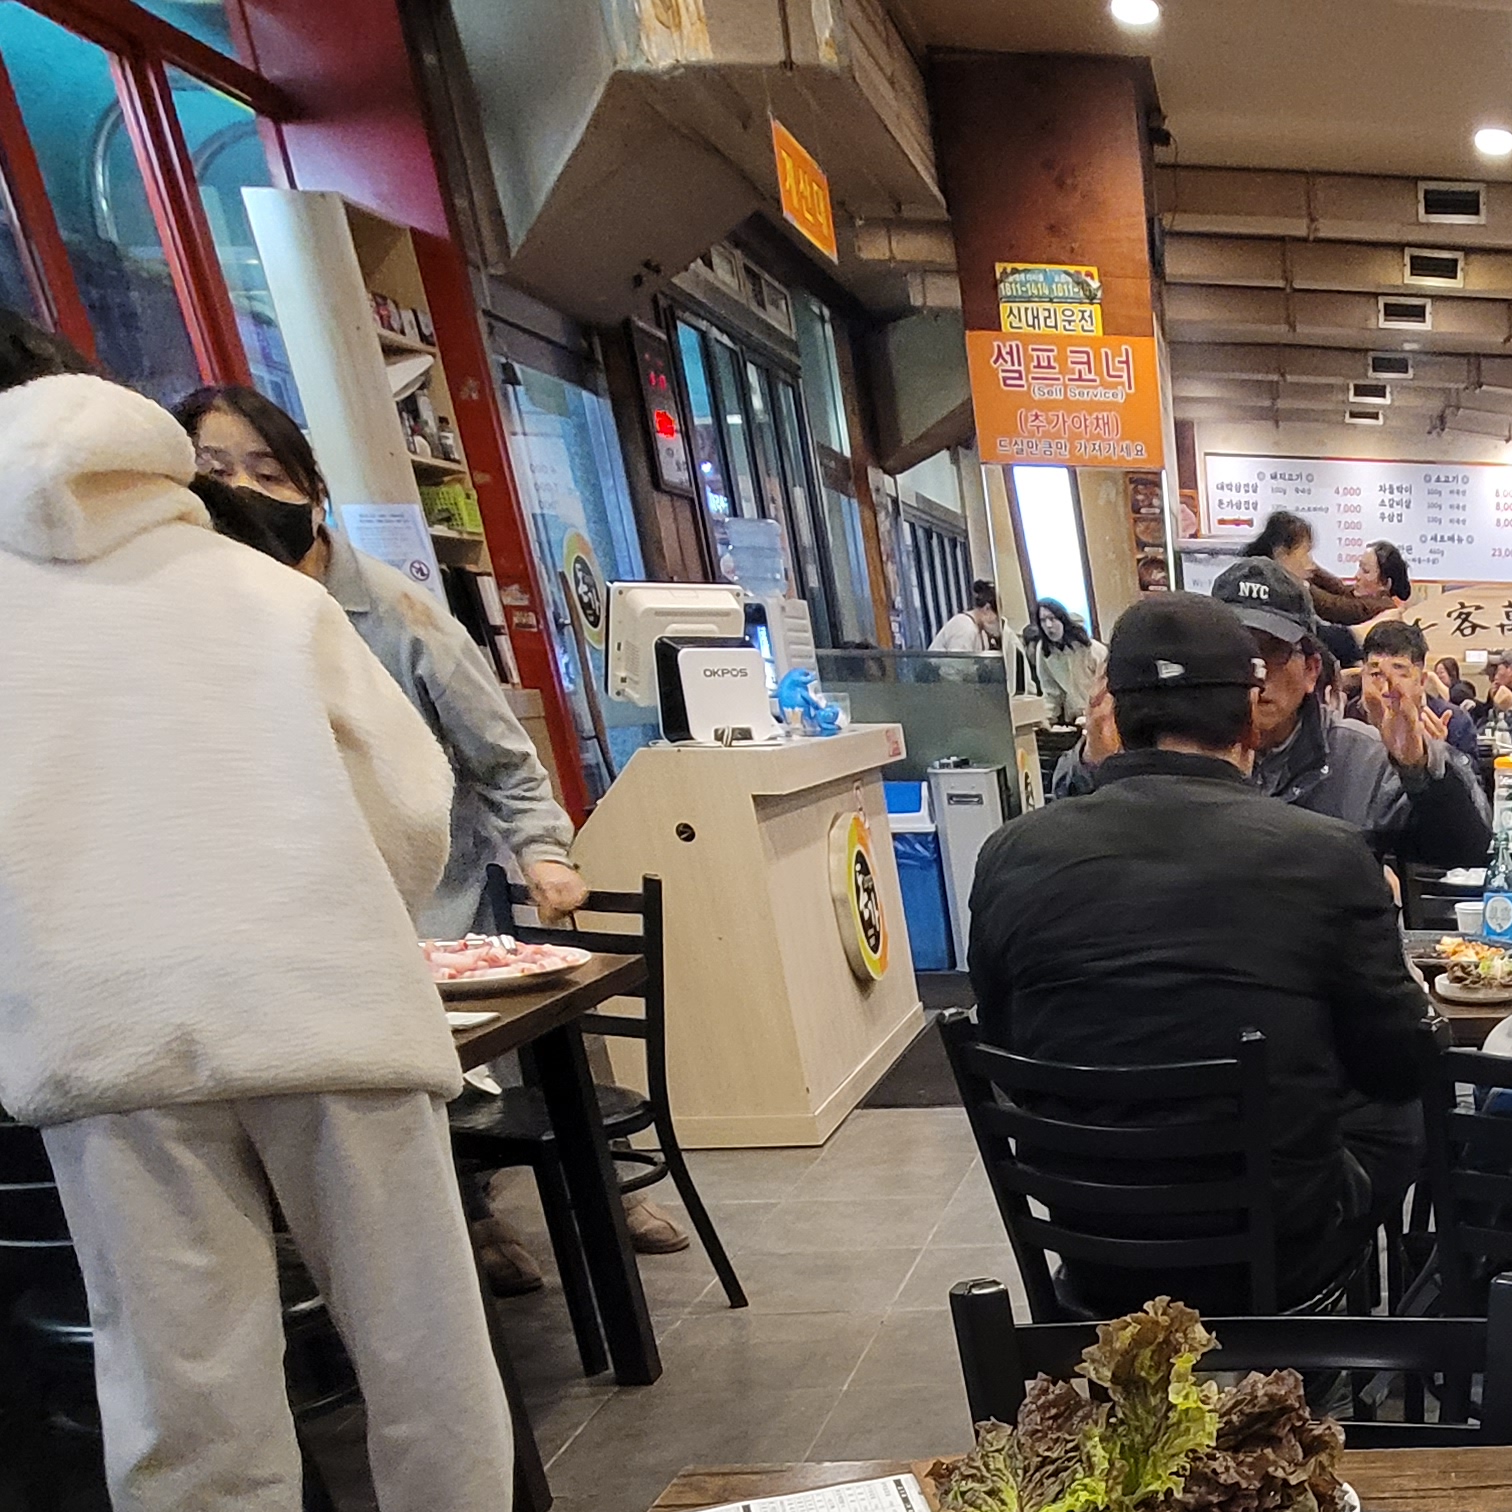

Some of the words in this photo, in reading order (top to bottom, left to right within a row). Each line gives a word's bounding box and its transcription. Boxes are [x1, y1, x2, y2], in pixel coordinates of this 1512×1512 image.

[1006, 305, 1095, 333] 신대리운전
[992, 342, 1133, 391] 셀프코너
[1032, 386, 1064, 399] (Self
[1068, 387, 1126, 402] Service)
[1018, 409, 1120, 438] (추가야채)
[998, 438, 1069, 457] 드실만큼만
[1334, 486, 1361, 497] 4,000
[1237, 581, 1269, 600] NYC
[703, 667, 749, 678] OKPOS
